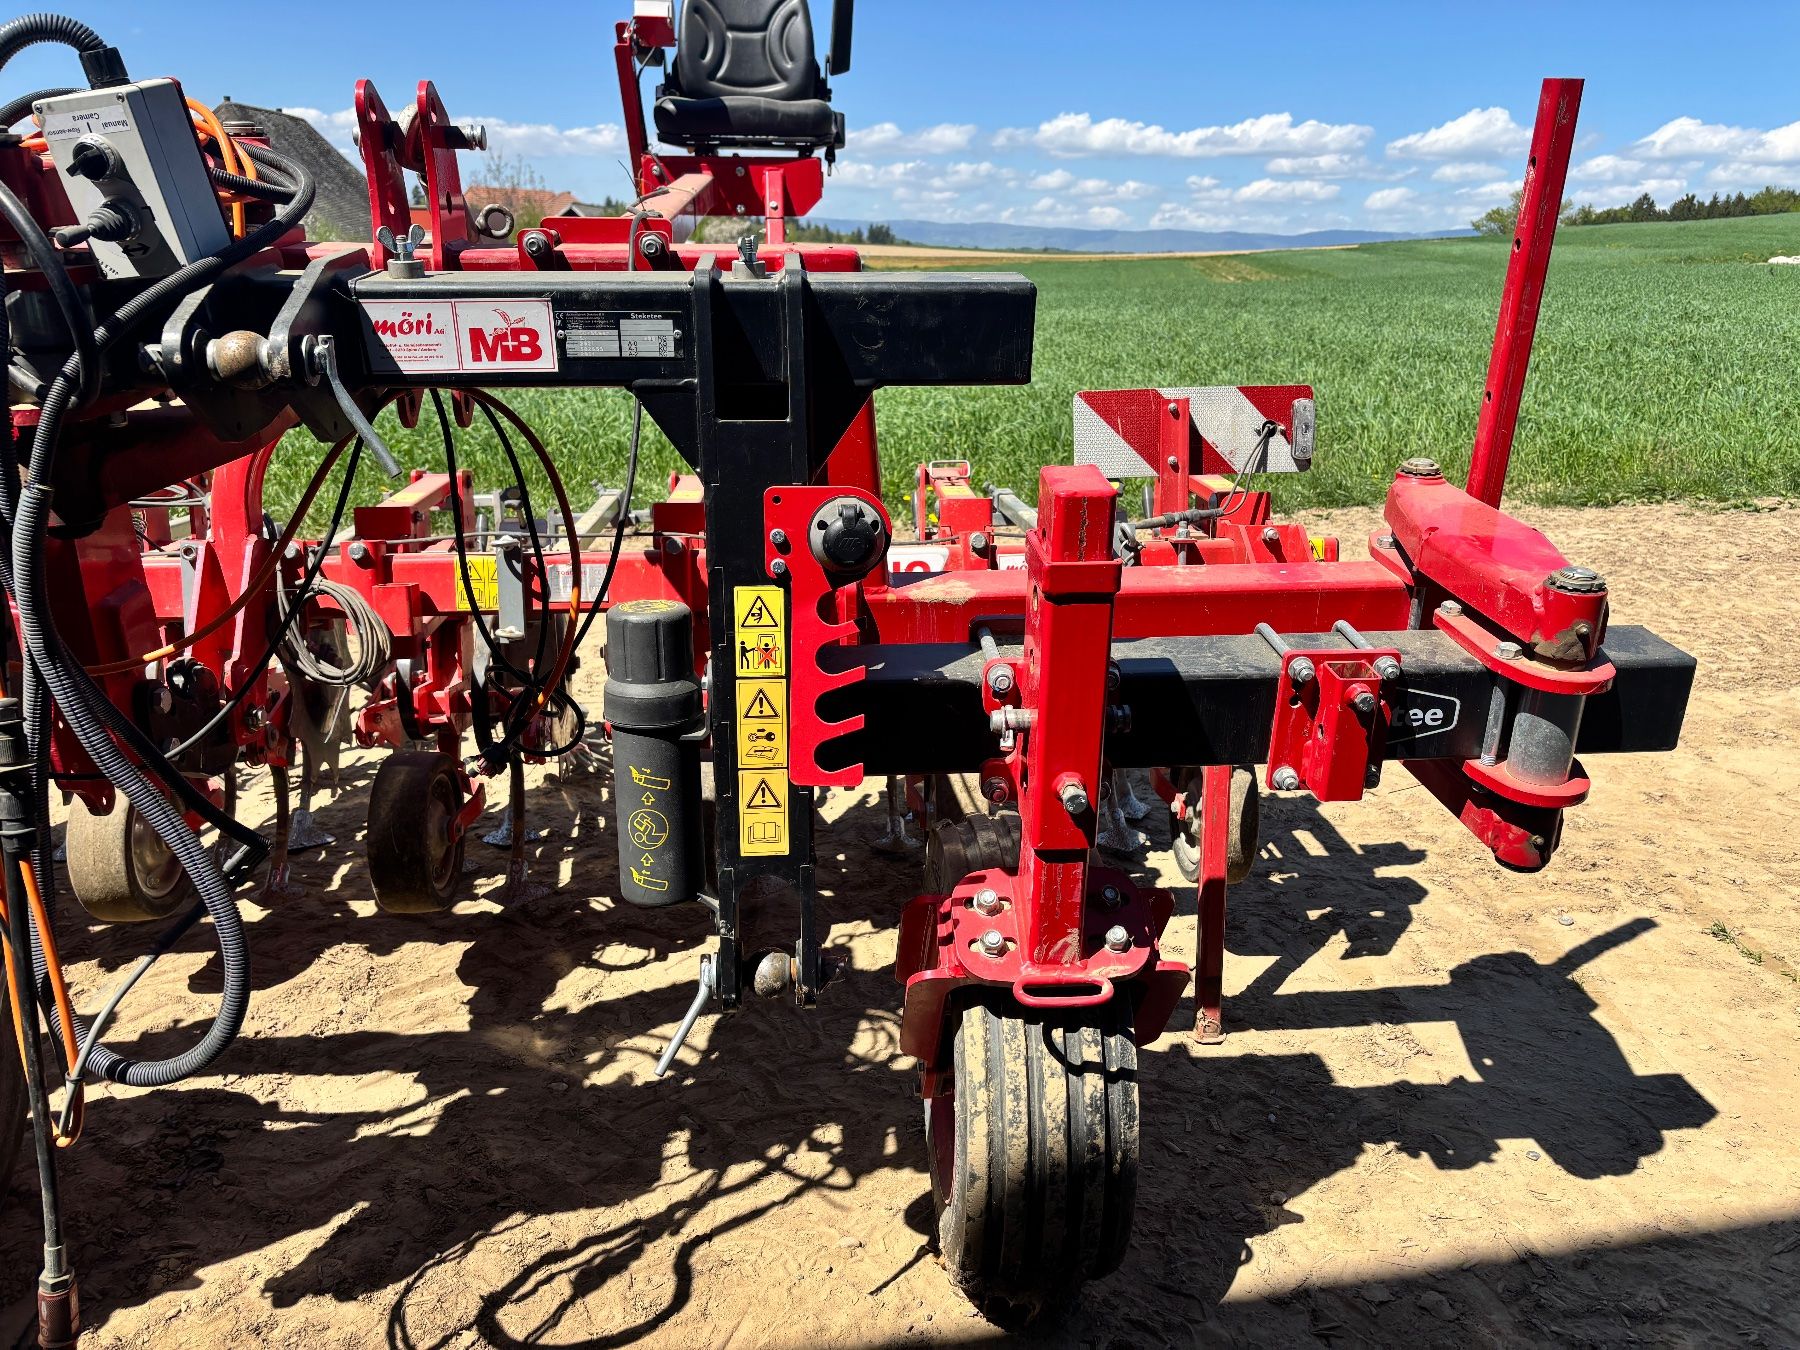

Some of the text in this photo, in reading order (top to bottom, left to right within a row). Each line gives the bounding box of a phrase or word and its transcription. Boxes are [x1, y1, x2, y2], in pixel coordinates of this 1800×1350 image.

[71, 112, 100, 122] Camera
[101, 119, 129, 130] Manual
[630, 312, 663, 320] Steketee
[372, 312, 433, 338] möri
